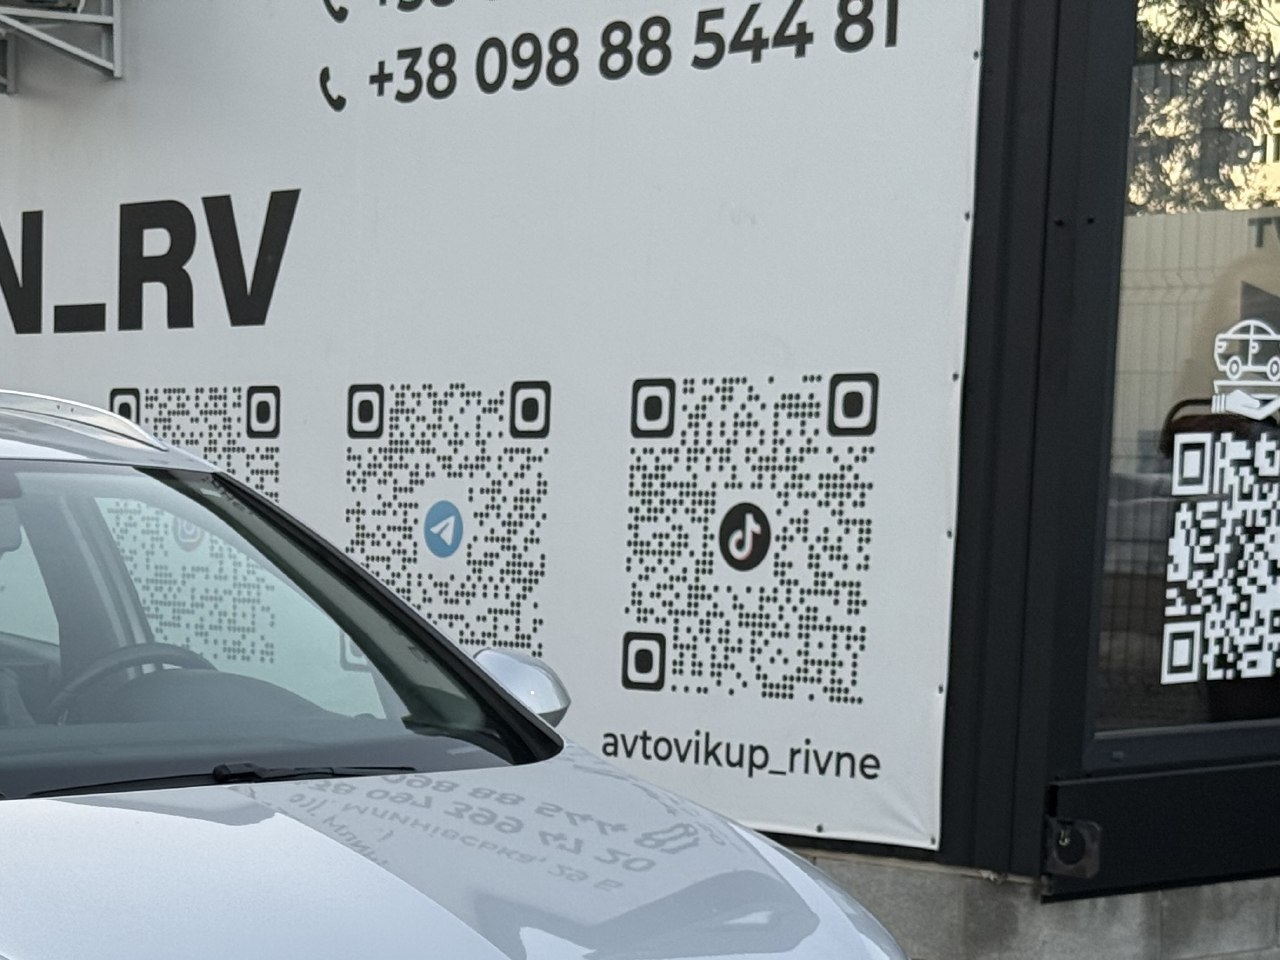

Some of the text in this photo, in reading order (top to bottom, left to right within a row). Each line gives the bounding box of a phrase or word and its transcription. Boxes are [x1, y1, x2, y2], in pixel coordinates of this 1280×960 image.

[369, 0, 909, 104] +38 098 88 544 81
[601, 729, 881, 780] avtovikup_rivne
